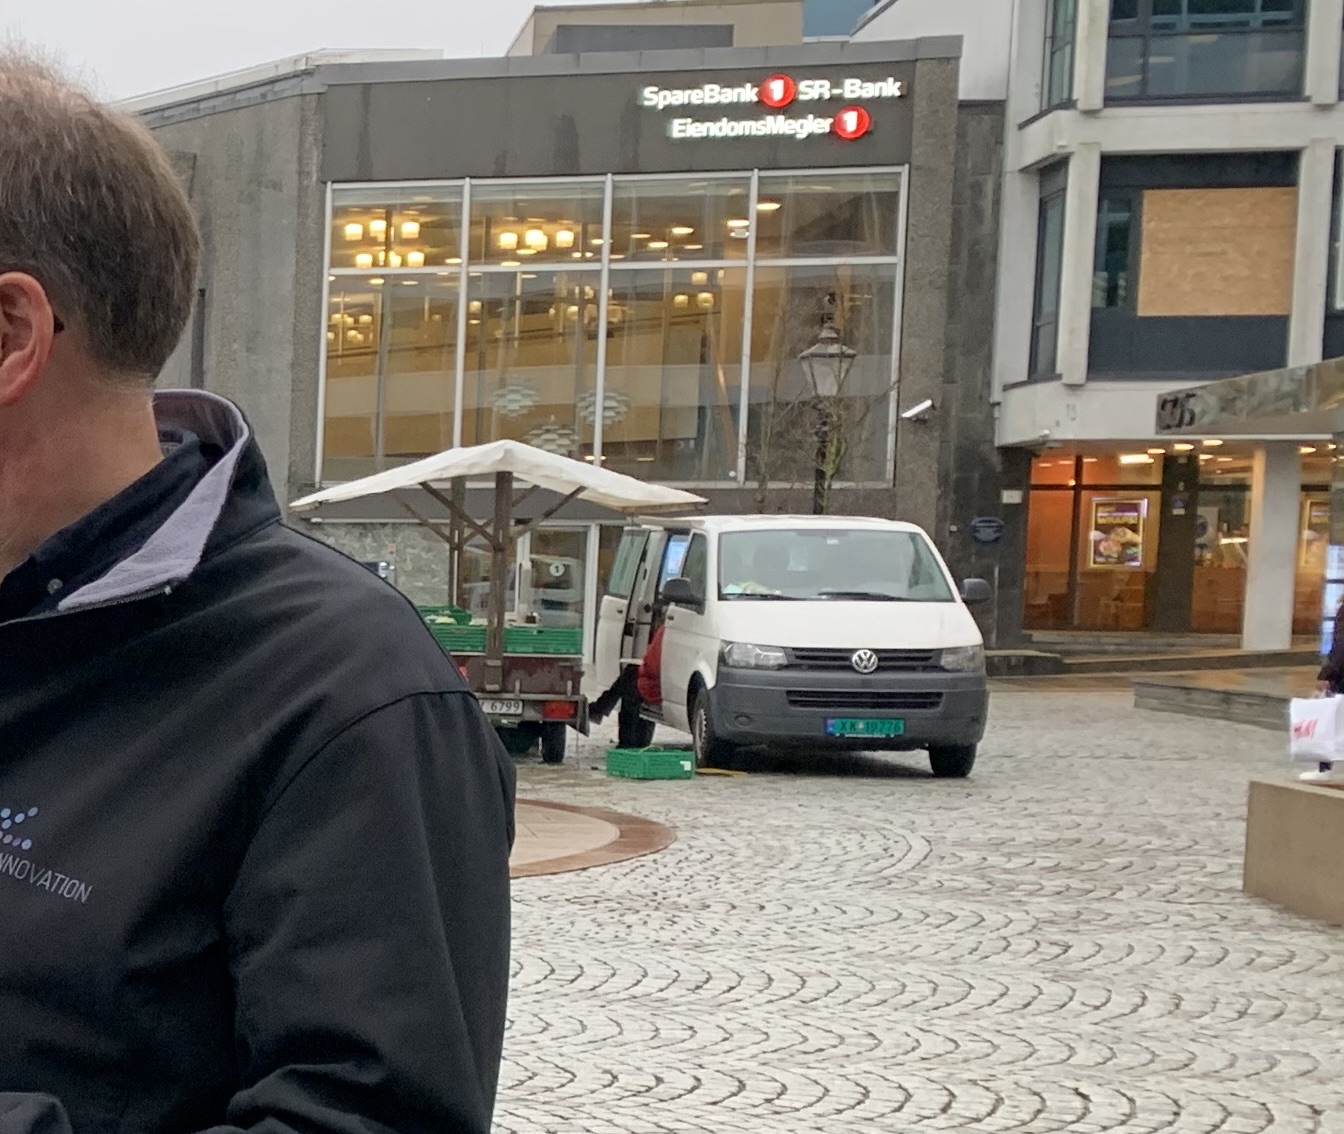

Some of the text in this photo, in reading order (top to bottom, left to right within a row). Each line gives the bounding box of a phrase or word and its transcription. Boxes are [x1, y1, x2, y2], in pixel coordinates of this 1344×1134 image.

[643, 82, 759, 109] SpareBank
[798, 77, 901, 100] SR-Bank
[672, 114, 834, 139] EiendomsMegler
[490, 700, 520, 712] 6799
[840, 720, 856, 732] XK
